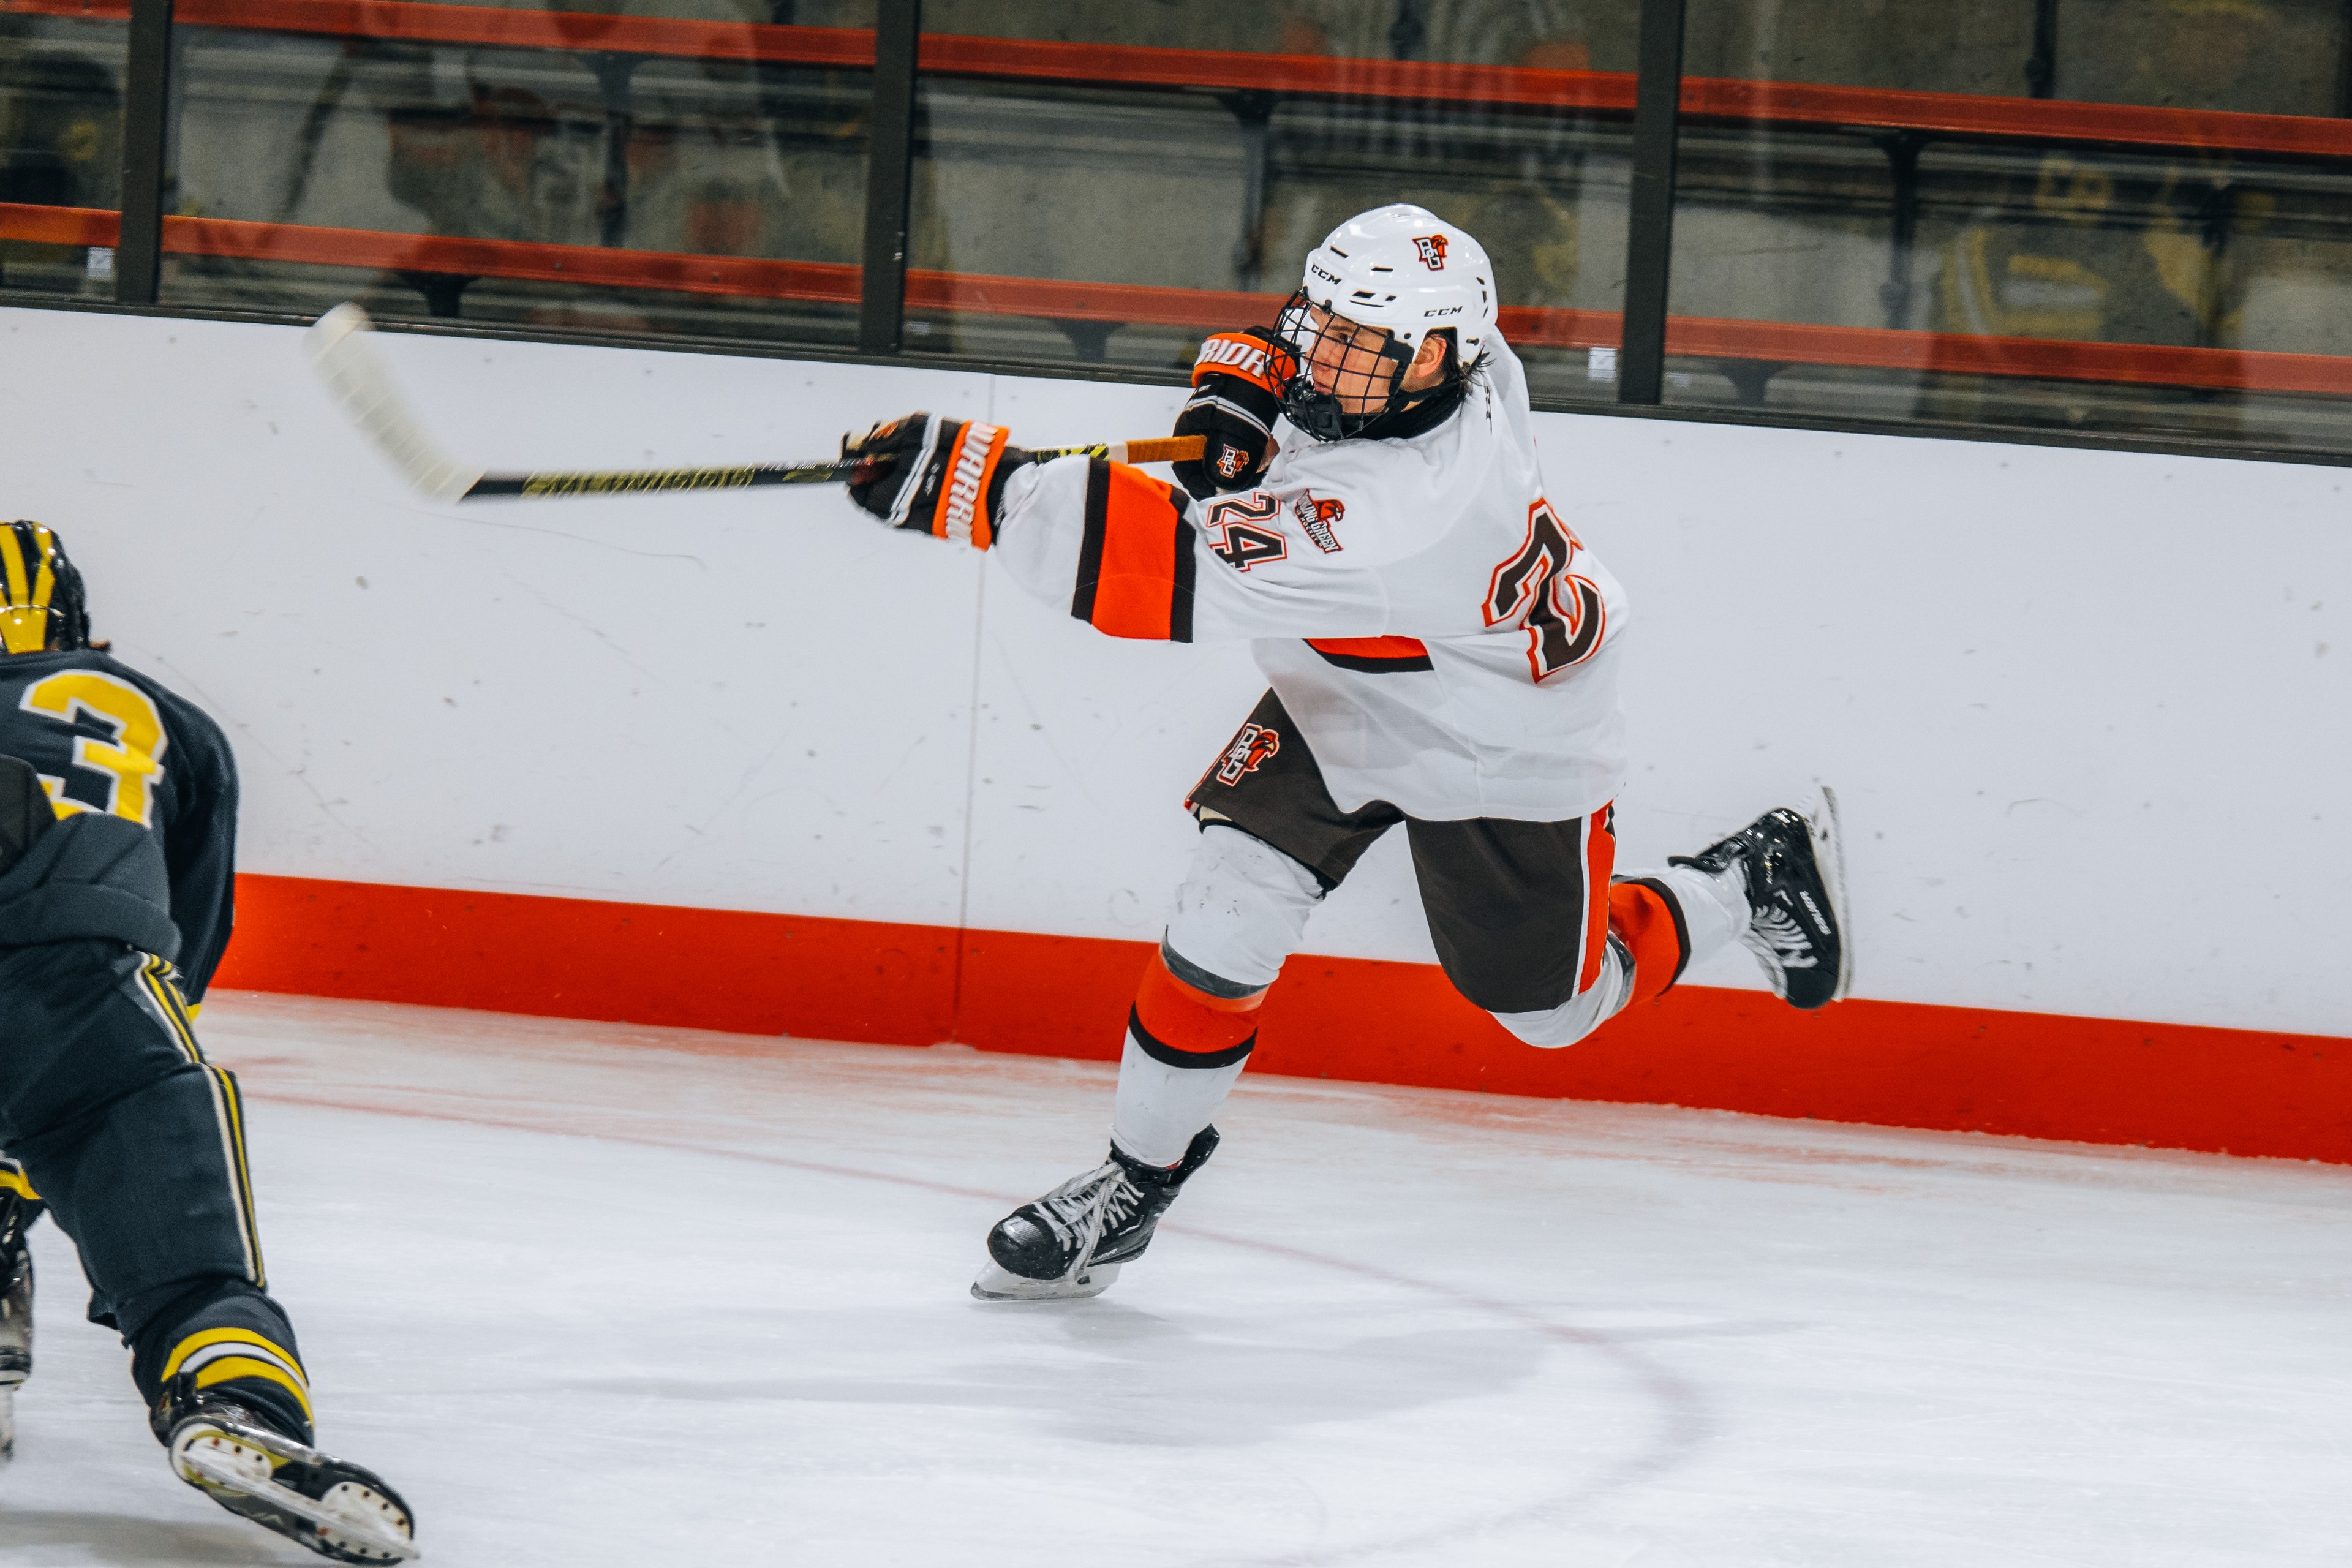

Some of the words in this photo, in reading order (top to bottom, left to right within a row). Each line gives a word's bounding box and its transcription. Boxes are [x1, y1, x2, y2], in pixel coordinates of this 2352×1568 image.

[1311, 263, 1343, 285] CCM
[1423, 306, 1463, 317] CCM
[1194, 339, 1272, 379] RIOR
[1205, 491, 1288, 573] 24
[1310, 519, 1340, 551] GREEN
[19, 669, 168, 830] 3
